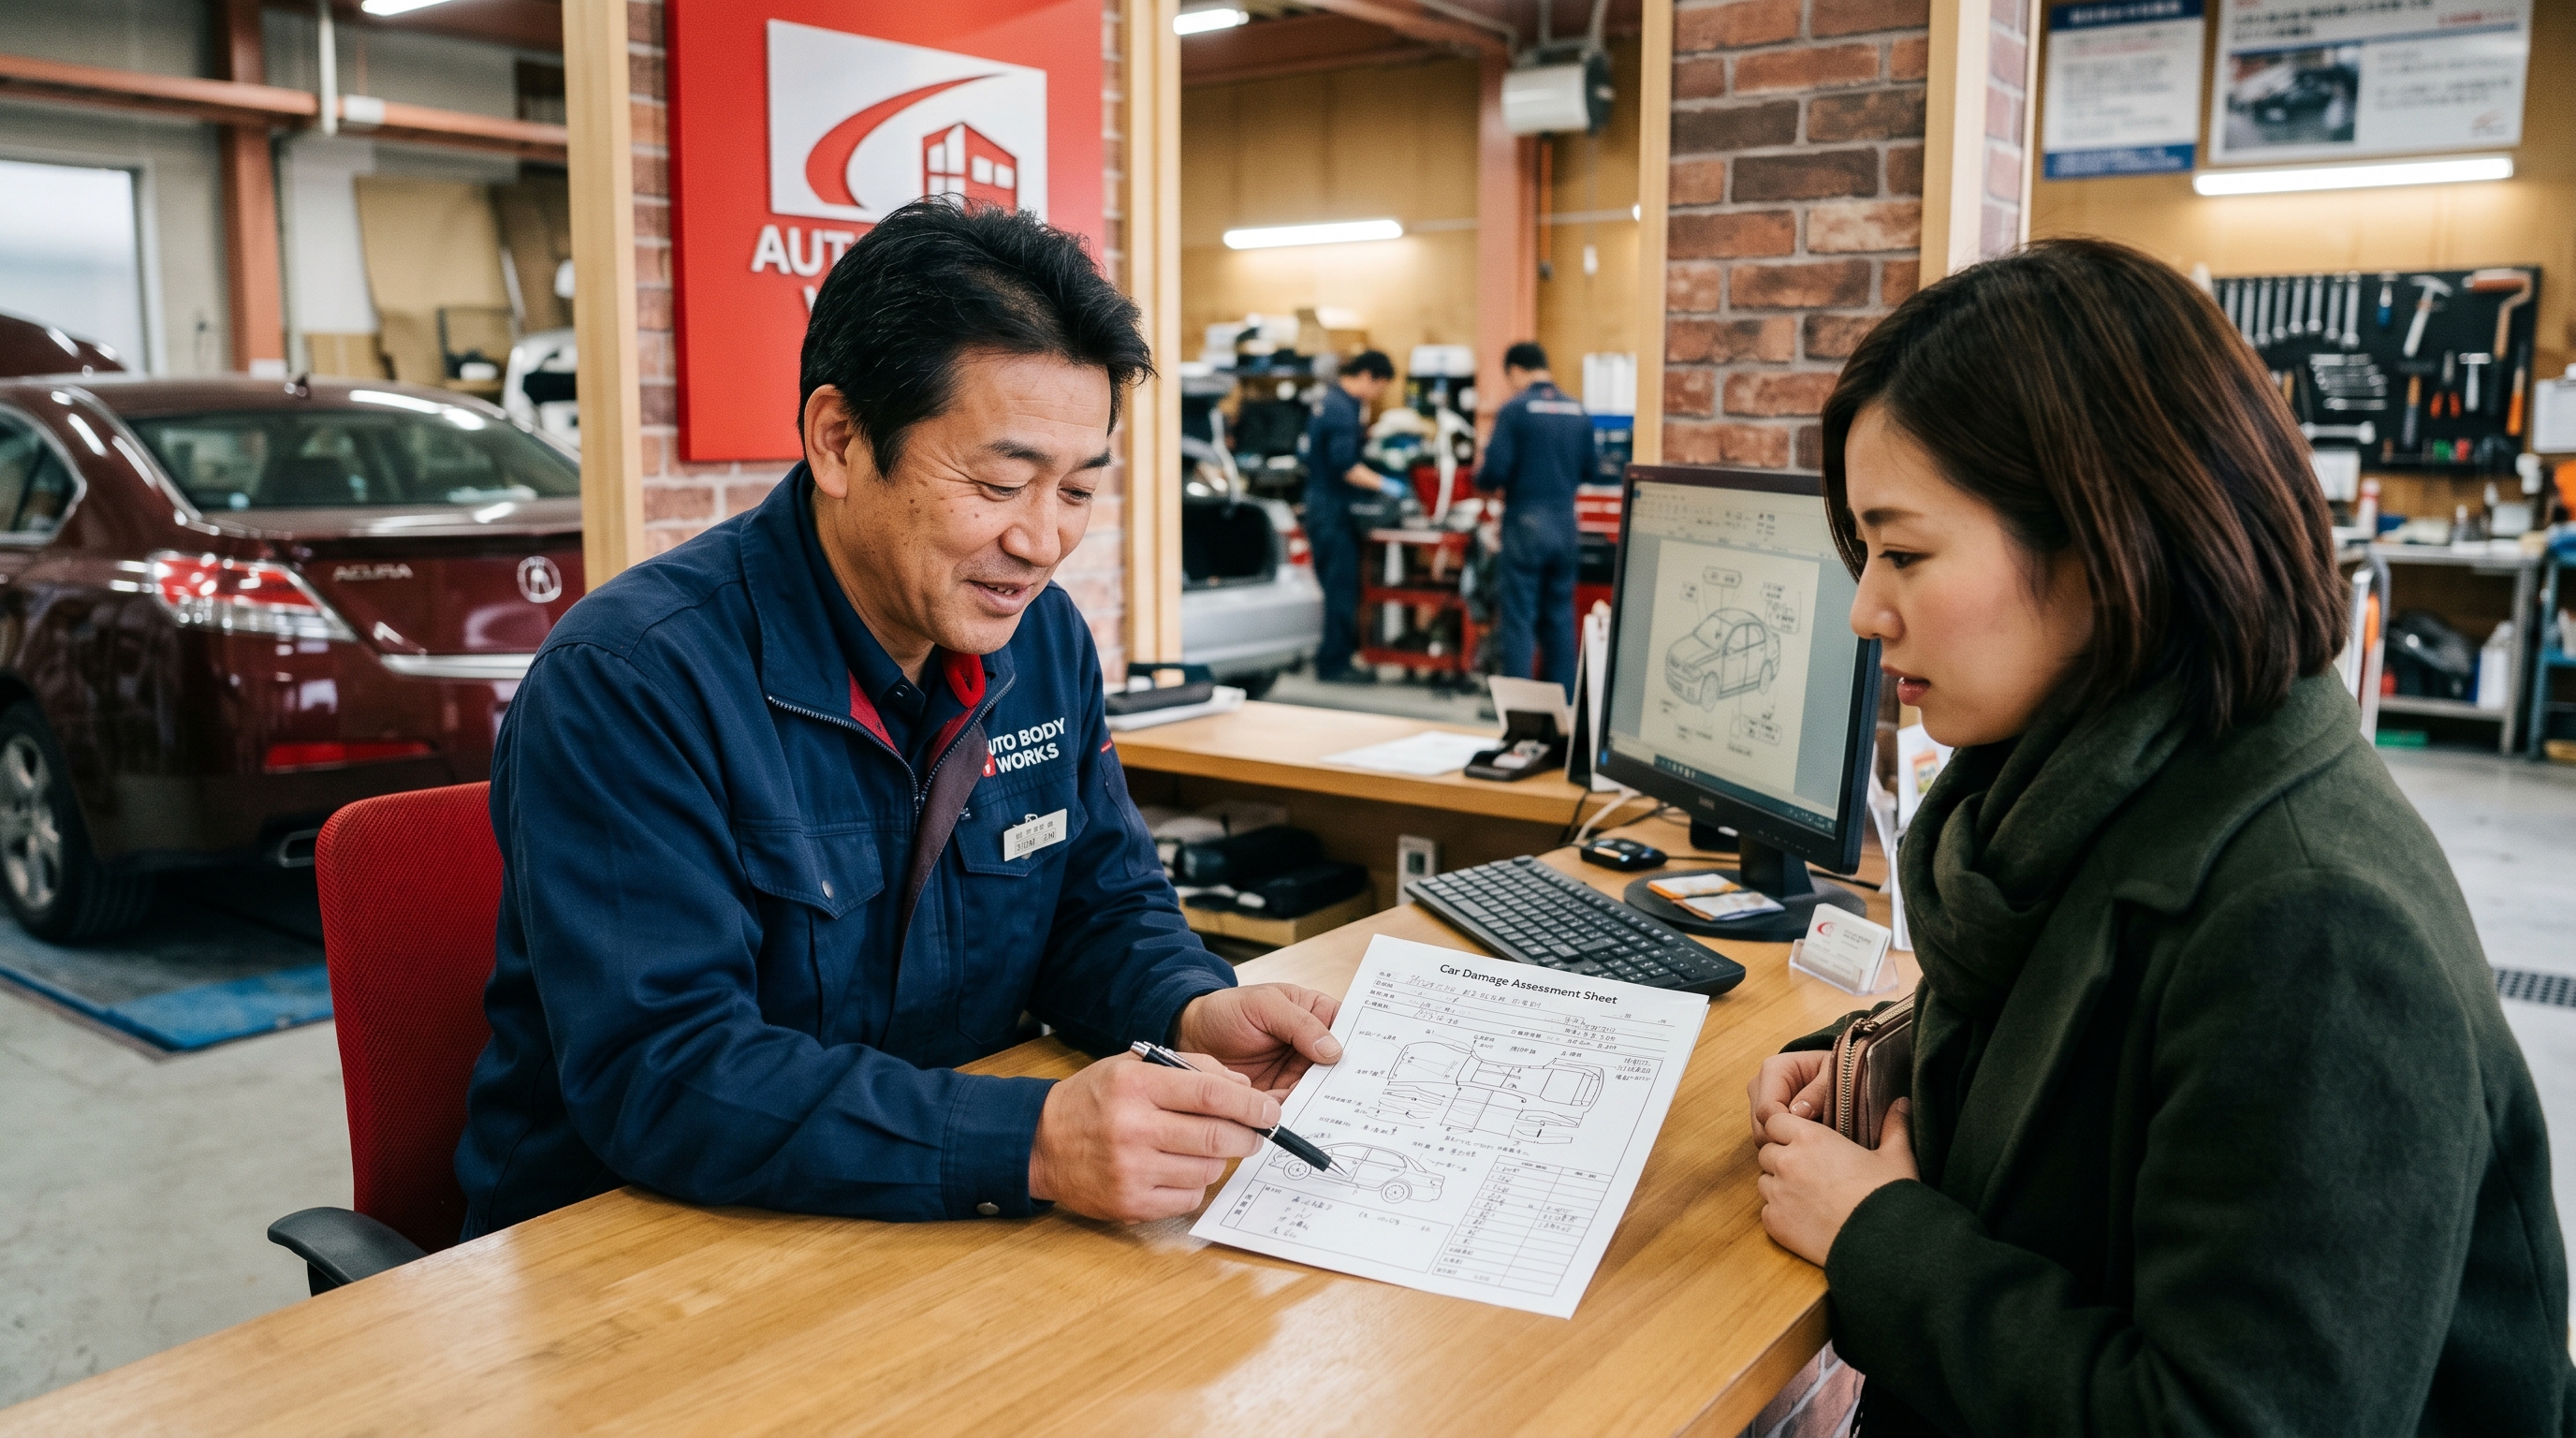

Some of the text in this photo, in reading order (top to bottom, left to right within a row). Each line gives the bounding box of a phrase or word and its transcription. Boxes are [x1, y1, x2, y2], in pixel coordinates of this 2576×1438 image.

[751, 224, 861, 277] AUT
[988, 717, 1065, 756] UTO BODY
[995, 742, 1060, 773] WORKS
[1440, 963, 1461, 976] Car
[1462, 969, 1509, 987] Damage
[1511, 978, 1581, 999] Assessment
[1583, 990, 1618, 1005] Sheet
